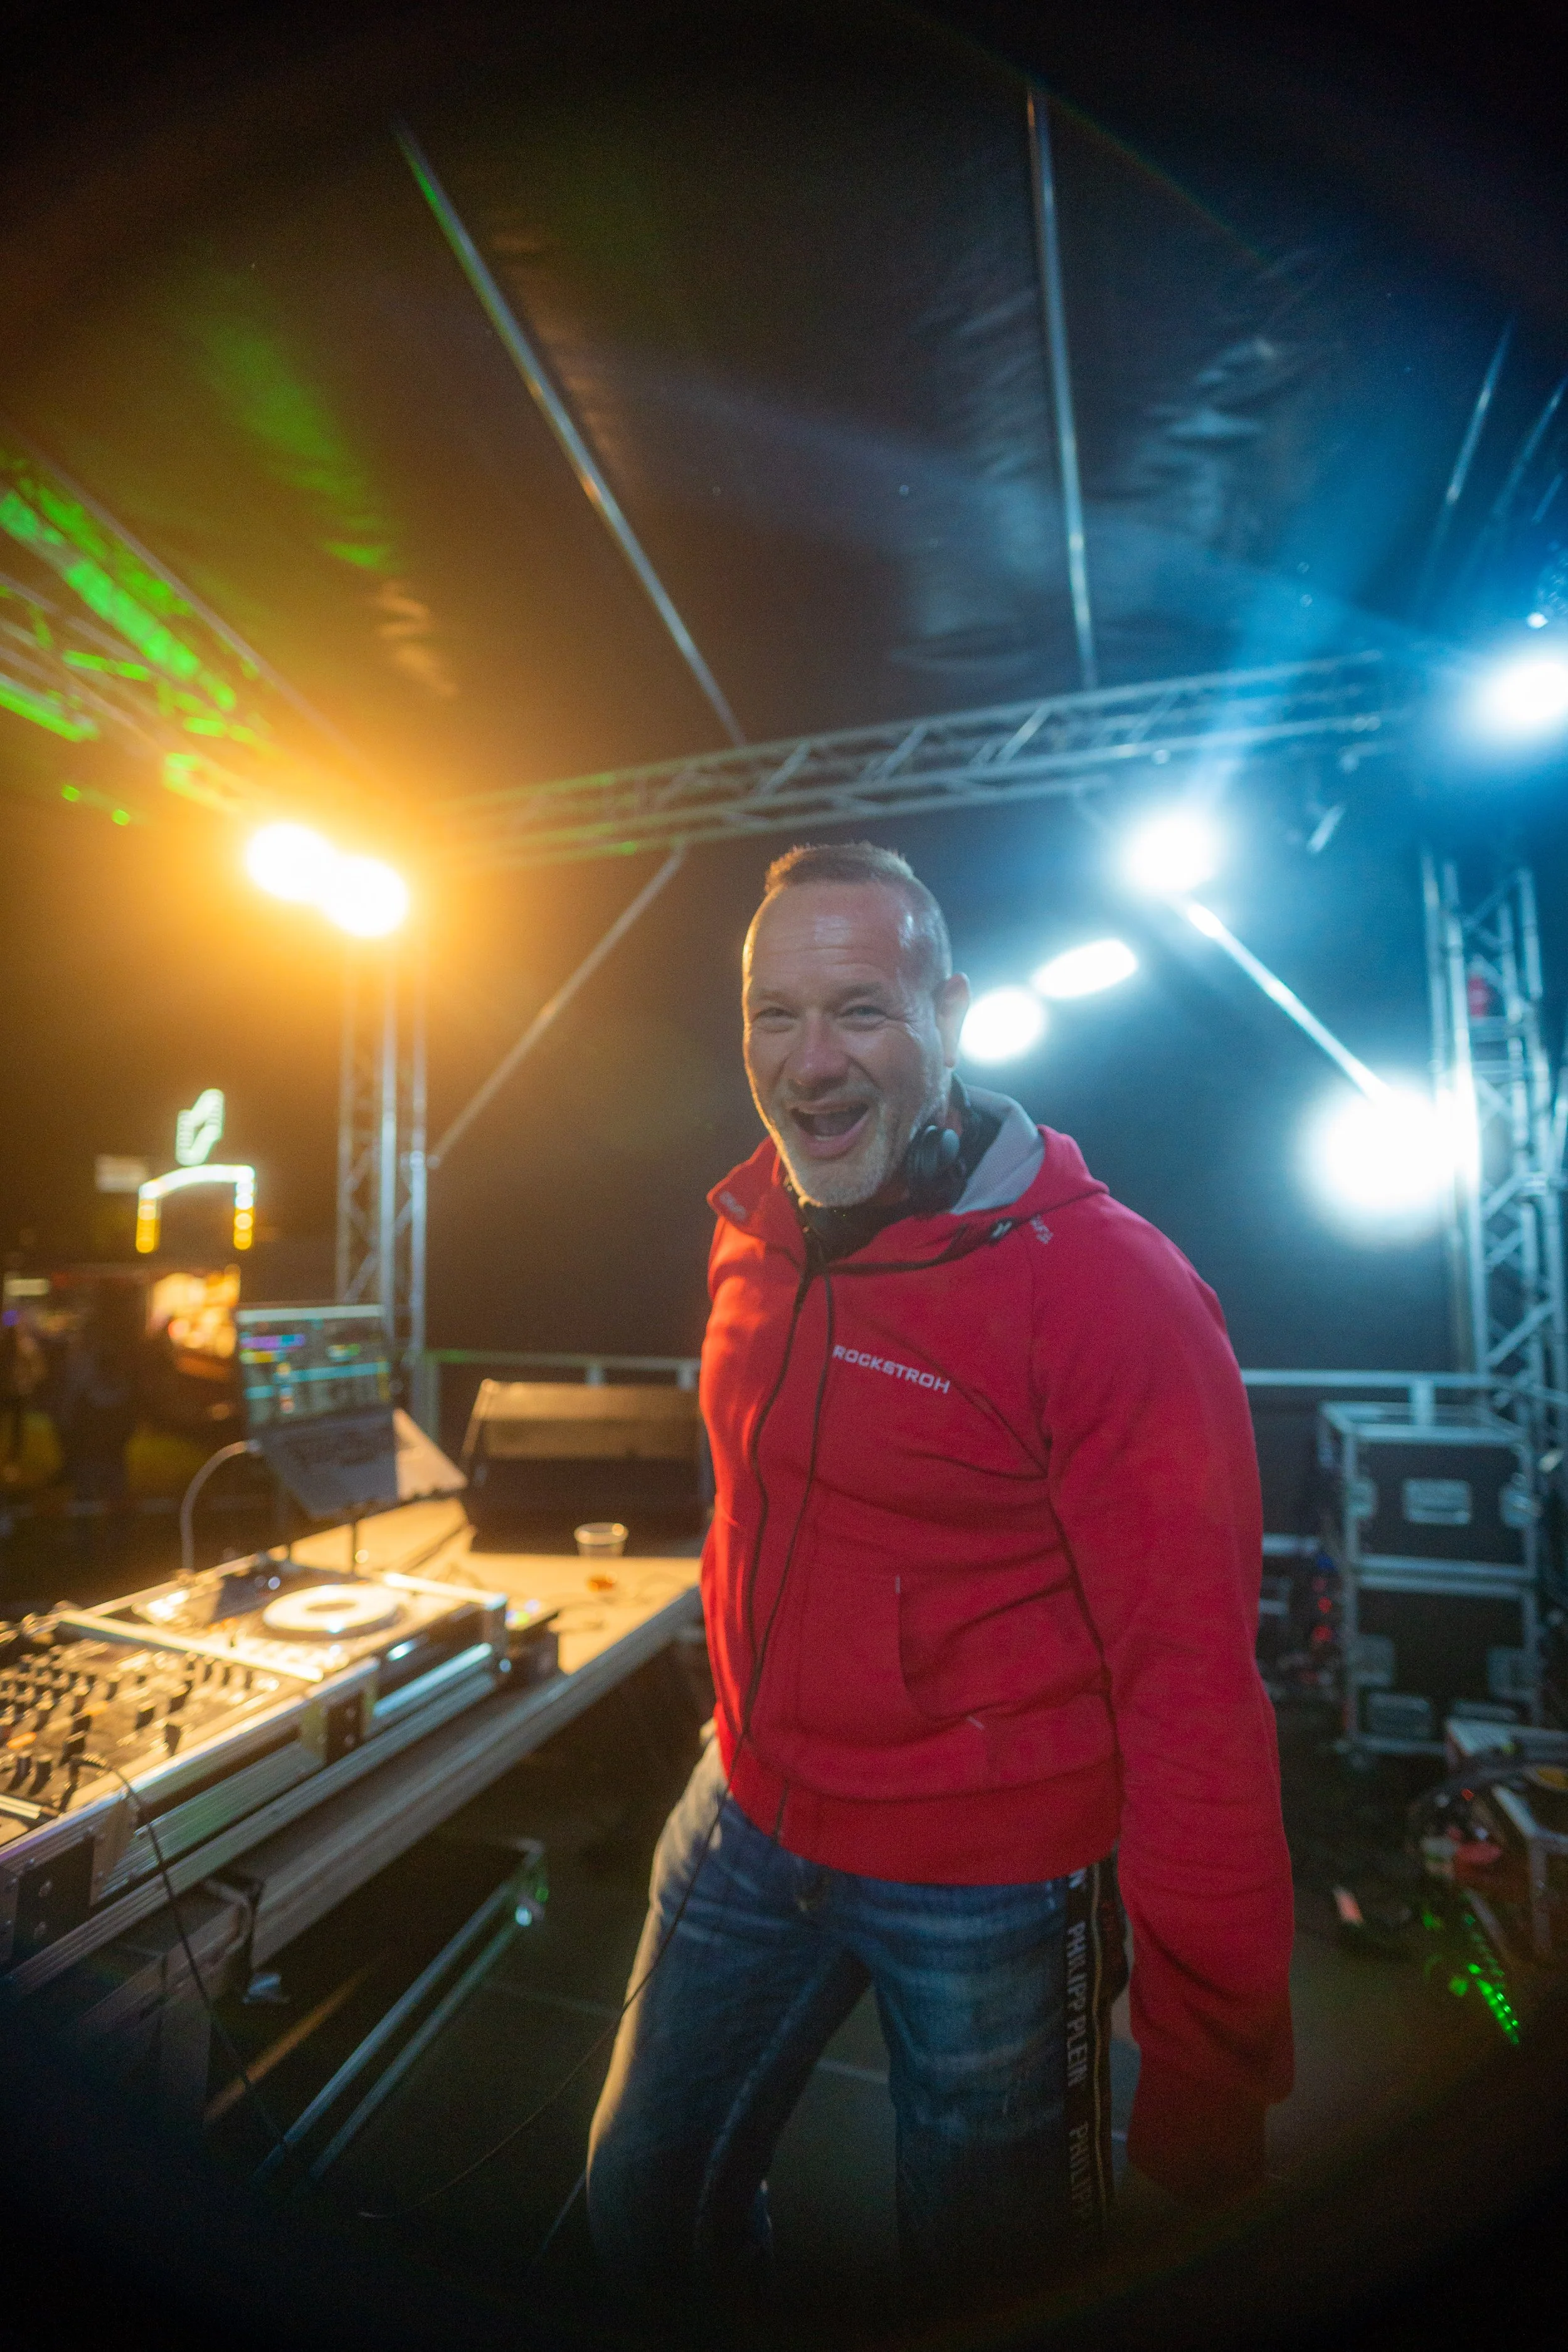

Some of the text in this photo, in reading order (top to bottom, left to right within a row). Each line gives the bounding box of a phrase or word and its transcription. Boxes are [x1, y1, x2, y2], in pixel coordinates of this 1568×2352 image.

[832, 1345, 950, 1394] ROCKSTROH
[1067, 1920, 1088, 2087] PHILIPP PLEIN
